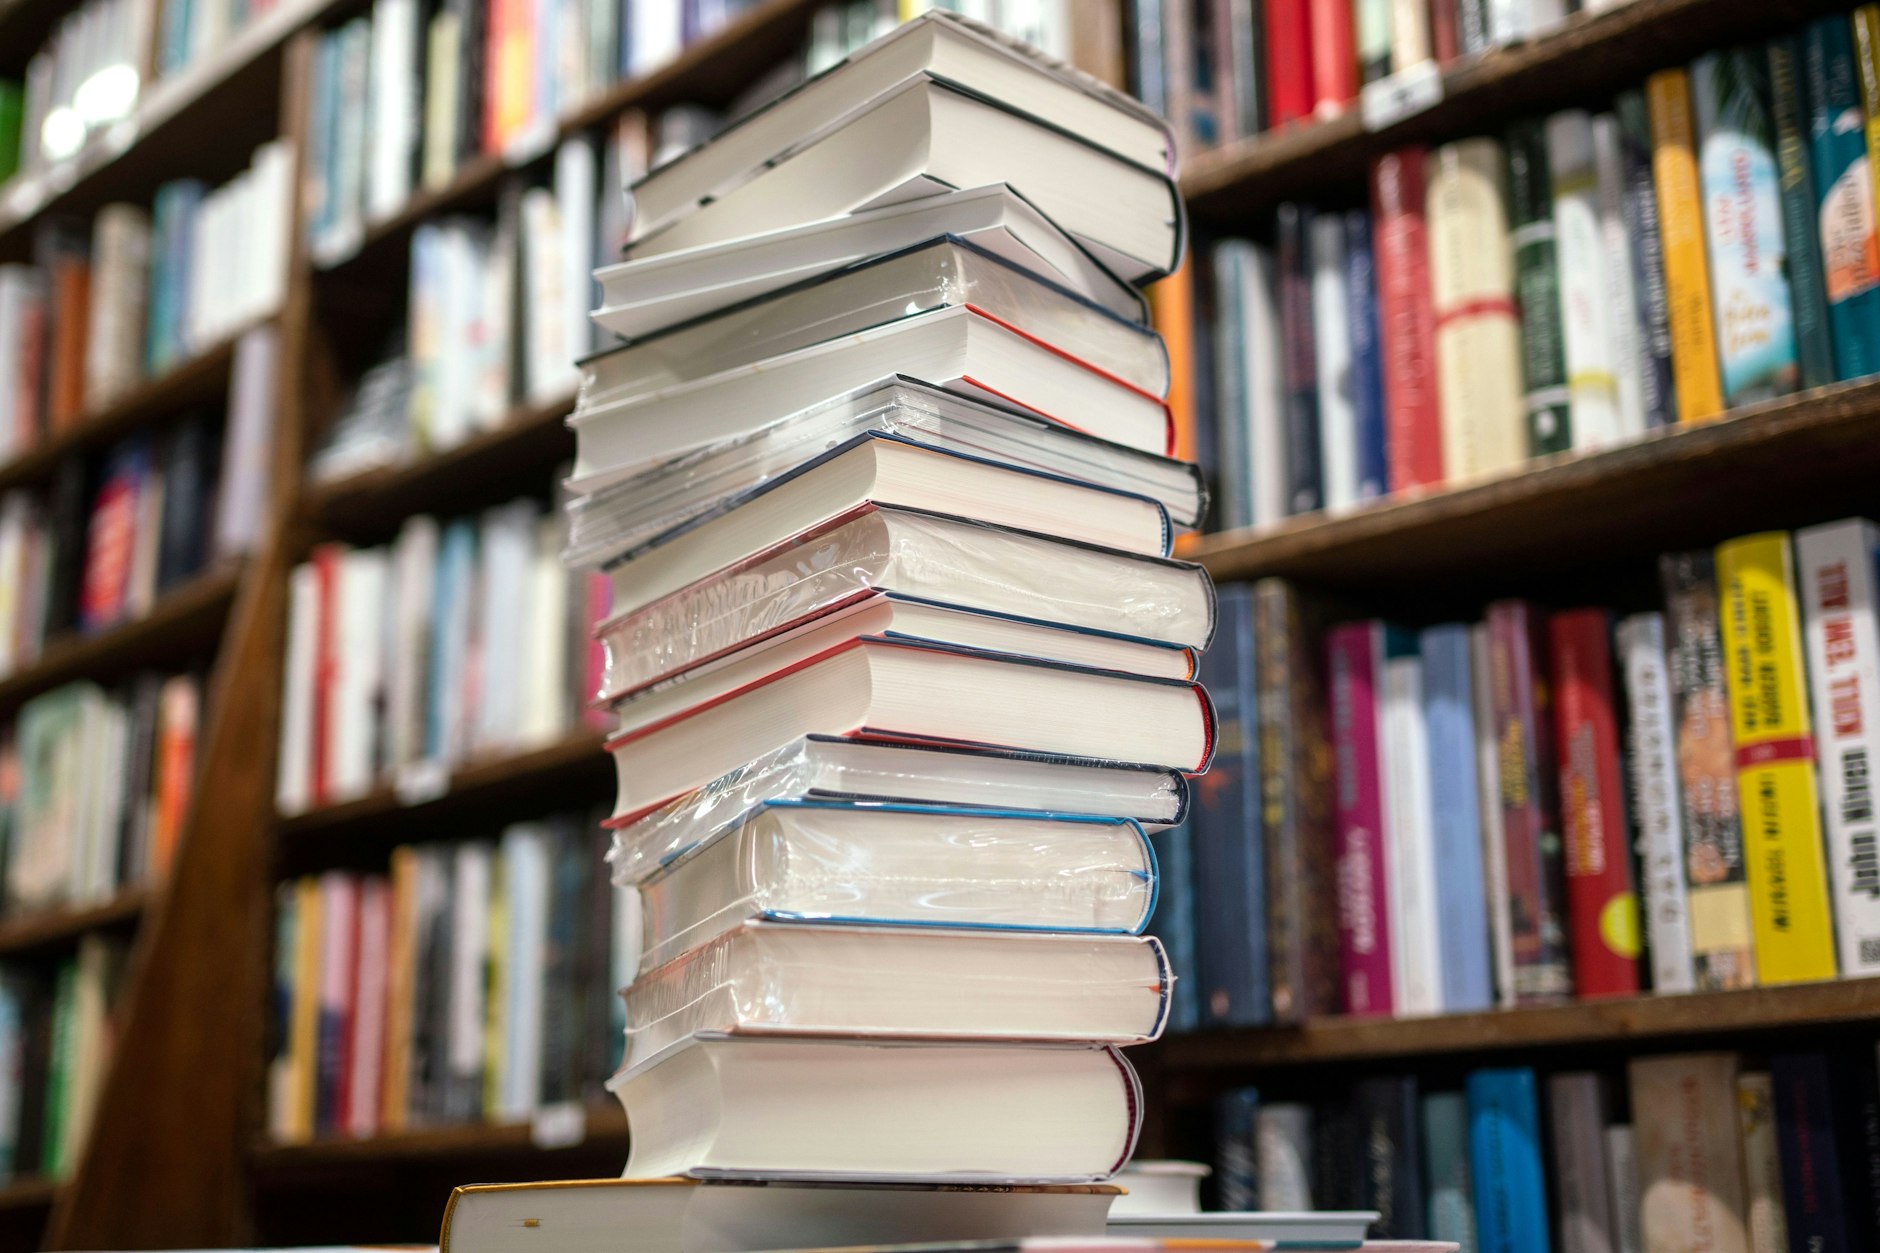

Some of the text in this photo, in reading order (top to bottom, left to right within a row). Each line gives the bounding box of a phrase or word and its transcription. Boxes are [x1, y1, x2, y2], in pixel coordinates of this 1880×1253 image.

[1818, 561, 1849, 609] ALL
[1831, 673, 1863, 738] KILL
[1842, 748, 1873, 824] Niven
[1849, 830, 1880, 901] John
